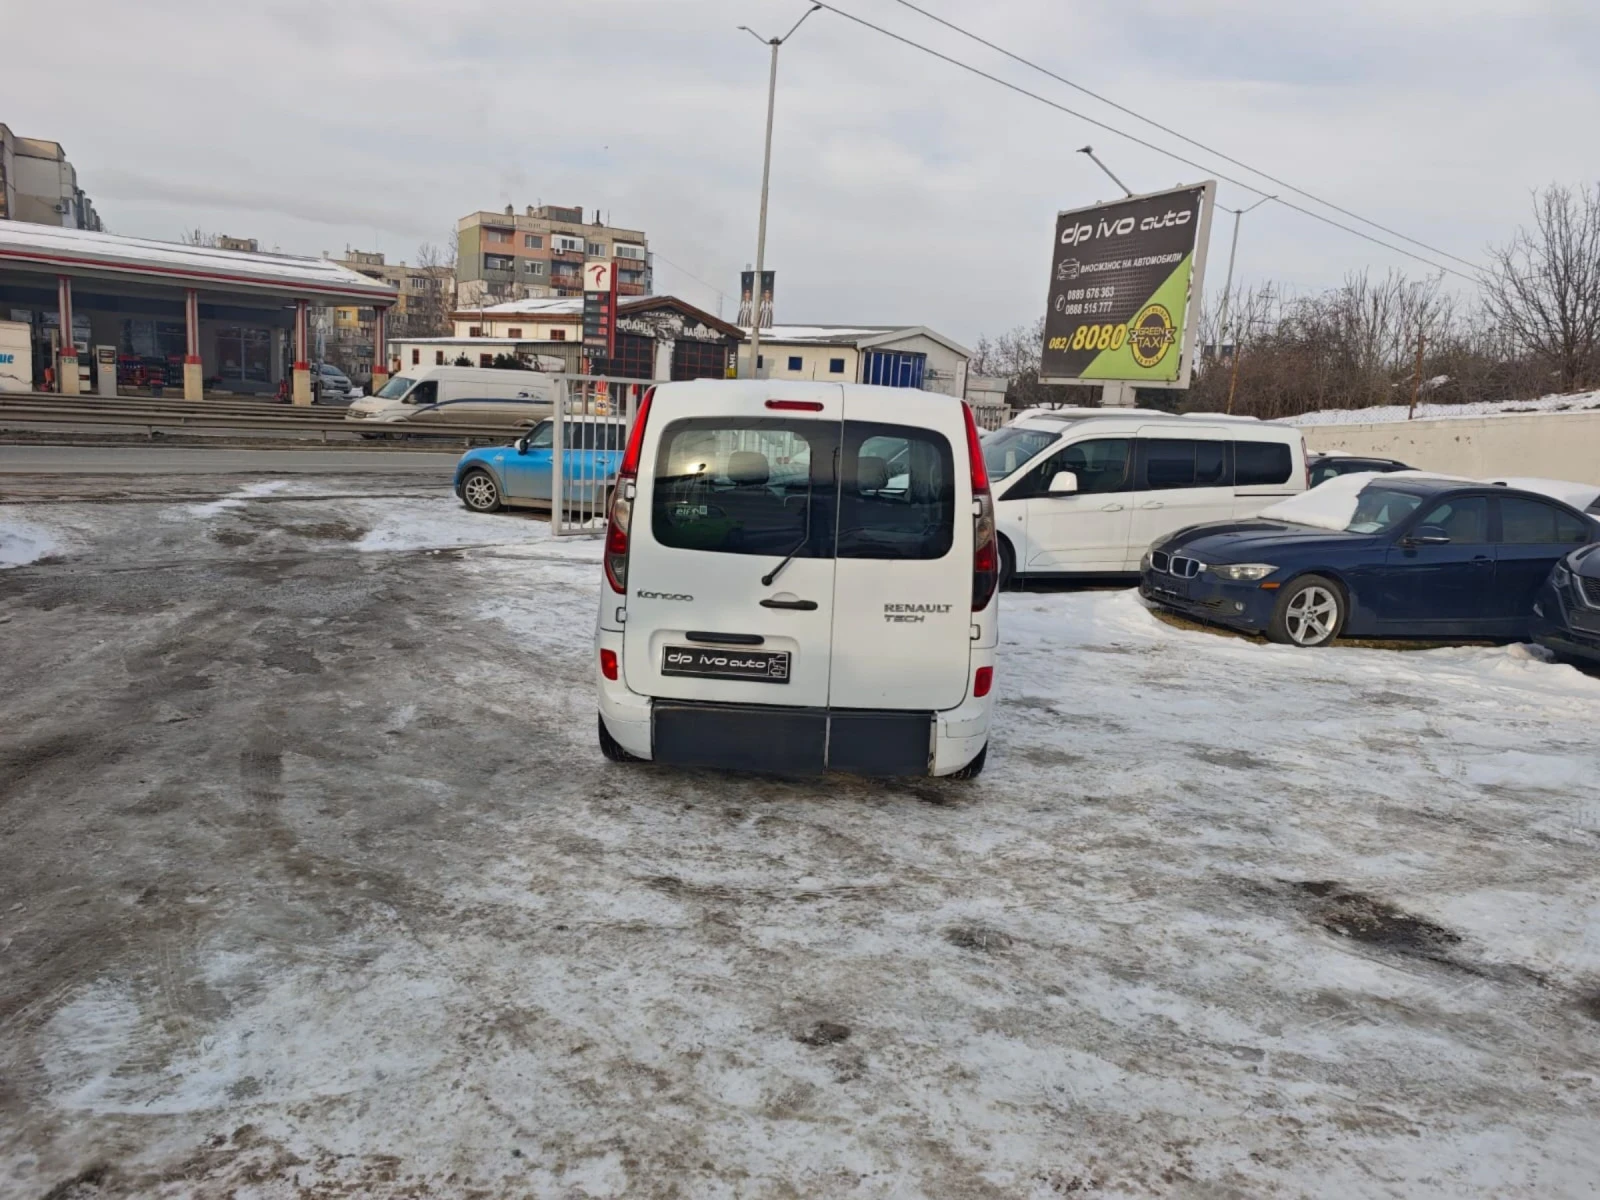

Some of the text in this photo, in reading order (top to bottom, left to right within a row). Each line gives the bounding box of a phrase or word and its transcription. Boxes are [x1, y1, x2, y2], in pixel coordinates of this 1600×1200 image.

[1061, 210, 1191, 246] dp ivo auto
[1133, 252, 1182, 268] АВТОМОБИЛИ
[1084, 302, 1098, 314] 515
[1100, 301, 1113, 313] 777
[1138, 326, 1165, 336] GREEN
[1137, 336, 1164, 348] TAXI
[884, 603, 953, 613] RENAULT
[884, 614, 925, 623] TECH
[667, 652, 767, 669] dp ivo auto
